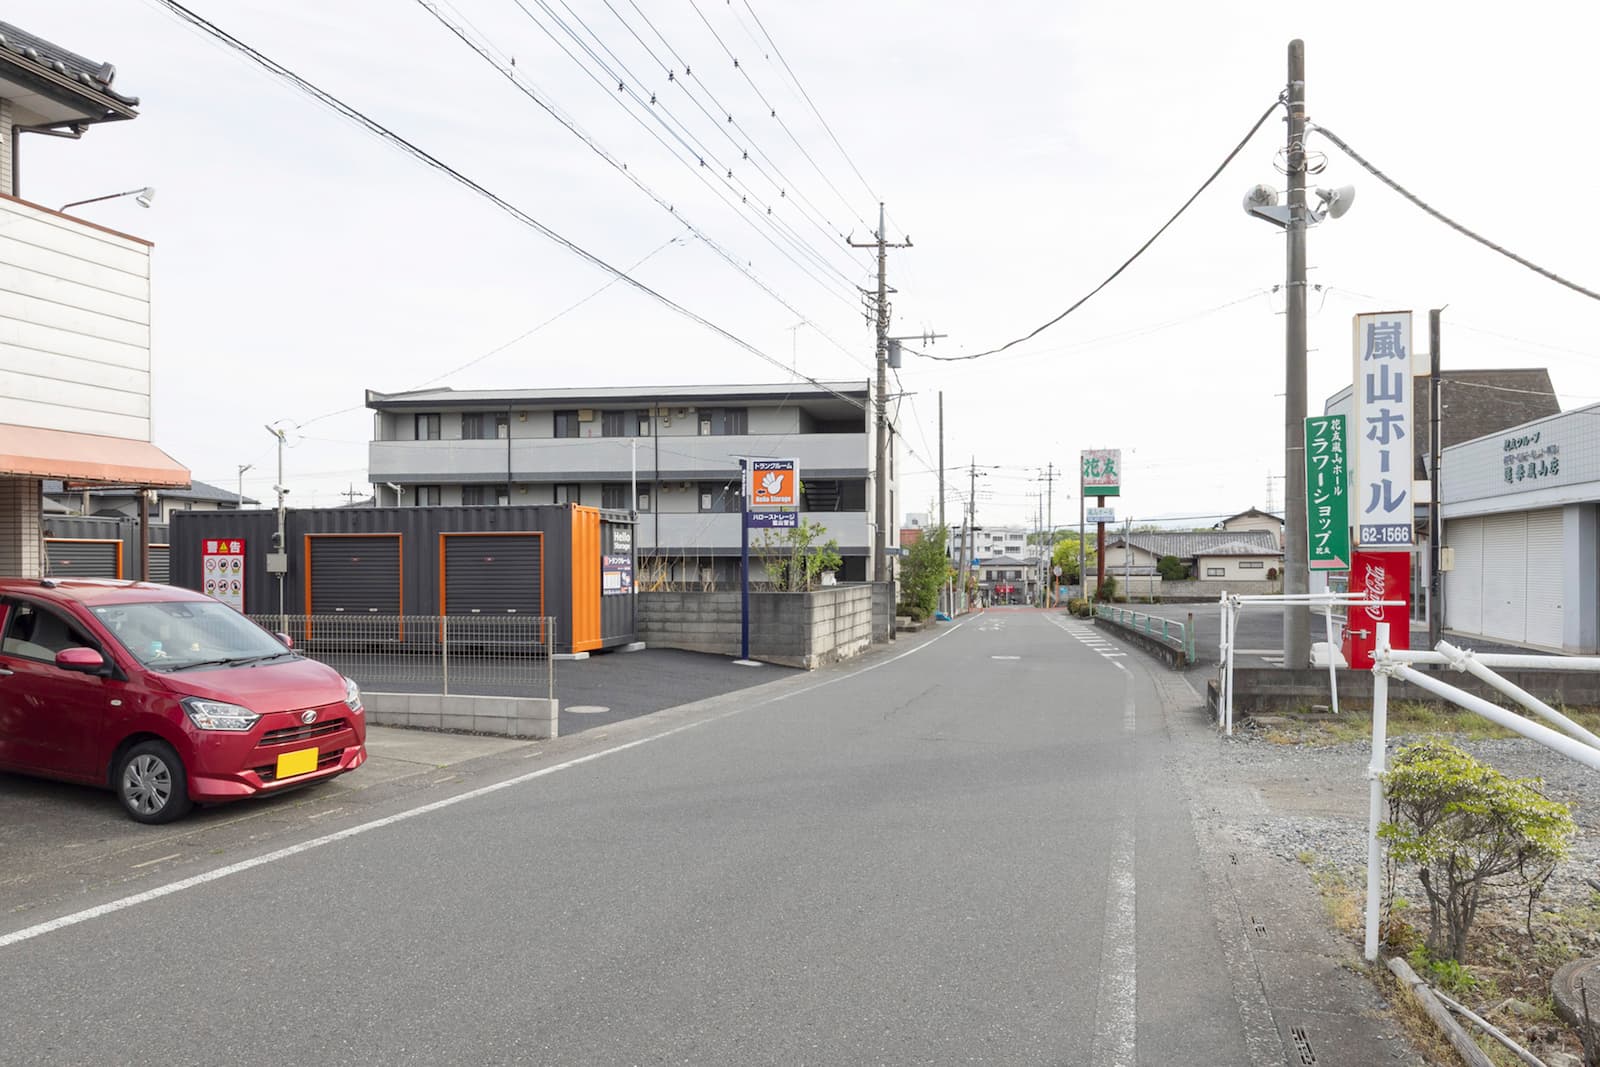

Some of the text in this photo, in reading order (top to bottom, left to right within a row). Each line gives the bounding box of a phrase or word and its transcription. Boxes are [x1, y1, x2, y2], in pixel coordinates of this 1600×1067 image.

[1364, 321, 1407, 514] 嵐山ホール
[754, 462, 792, 470] トランクルーム
[1331, 419, 1343, 497] 花友嵐山ホール
[1083, 458, 1117, 478] 花友
[1311, 421, 1332, 547] フラワーショップ
[752, 513, 795, 521] ハローストレージ
[613, 531, 631, 542] Hello
[1361, 527, 1409, 543] 62-1566
[613, 543, 631, 551] Storage
[1365, 563, 1385, 621] Coa-Cola
